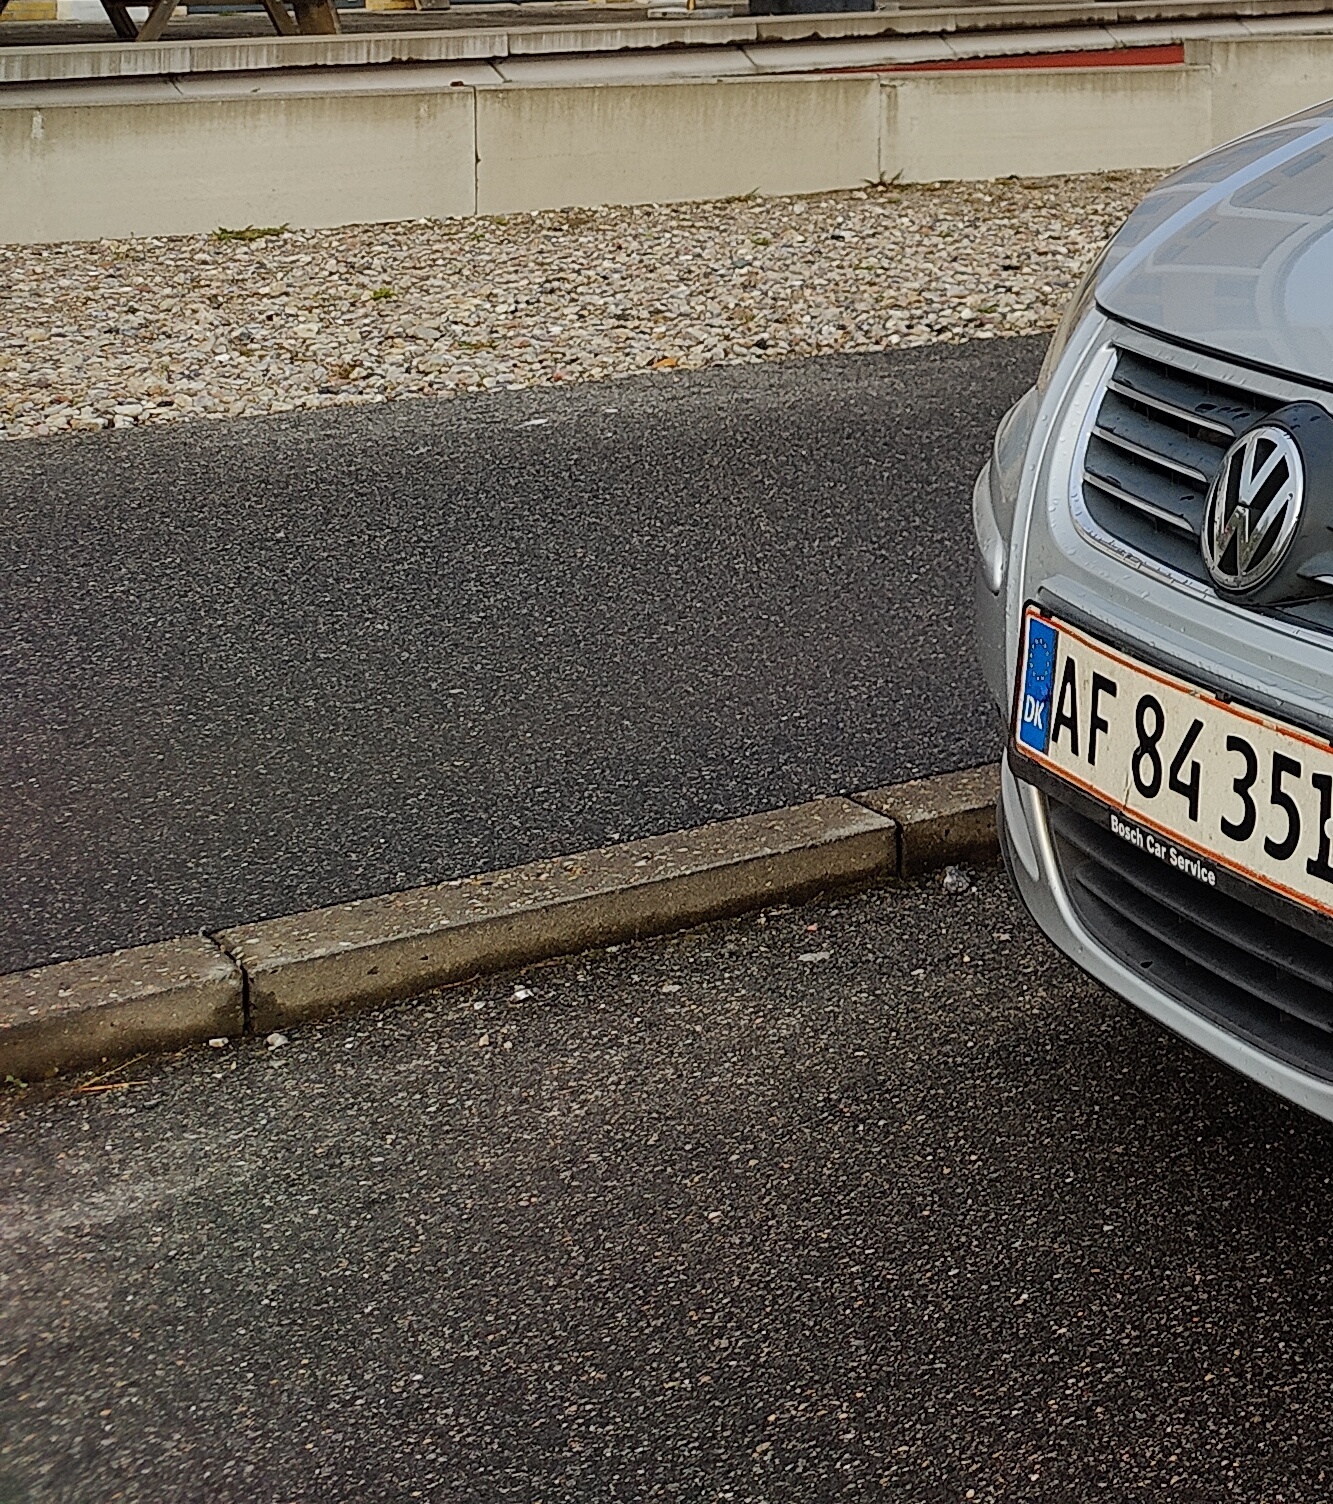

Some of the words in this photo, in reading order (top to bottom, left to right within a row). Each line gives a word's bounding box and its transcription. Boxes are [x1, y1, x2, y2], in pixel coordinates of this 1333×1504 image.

[1024, 694, 1045, 730] DK
[1051, 655, 1118, 766] AF
[1131, 693, 1204, 822] 84
[1110, 814, 1143, 848] Bosch
[1146, 835, 1167, 860] Car
[1169, 847, 1216, 886] Service
